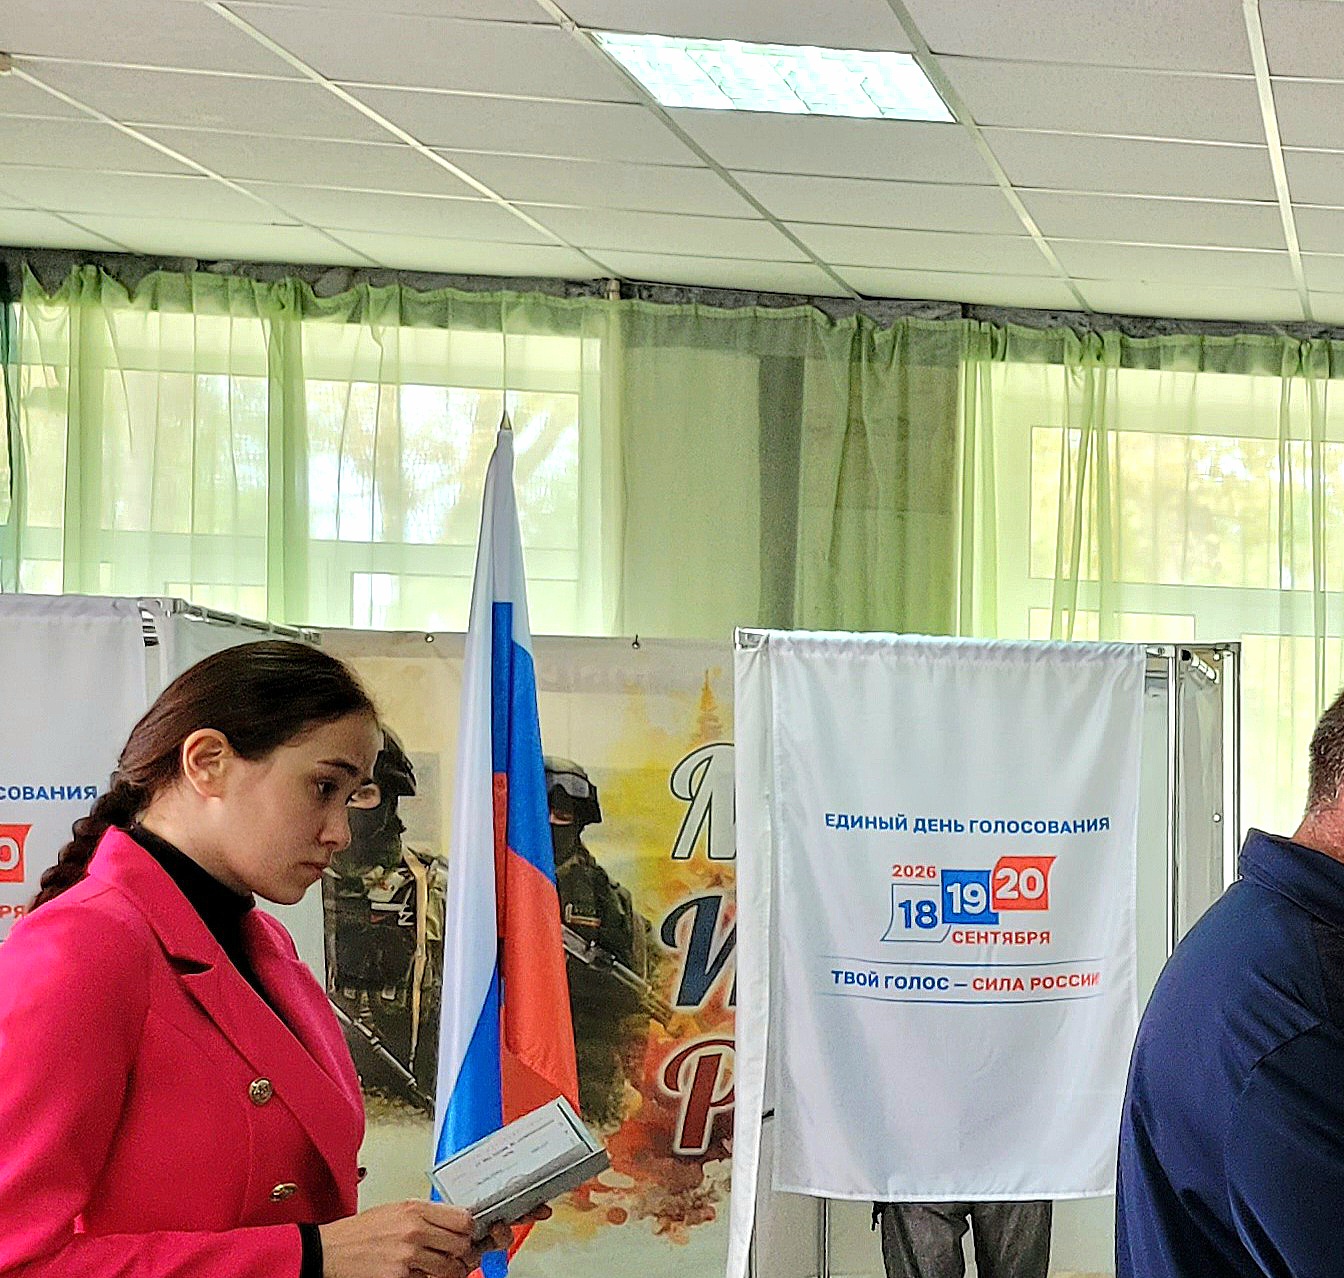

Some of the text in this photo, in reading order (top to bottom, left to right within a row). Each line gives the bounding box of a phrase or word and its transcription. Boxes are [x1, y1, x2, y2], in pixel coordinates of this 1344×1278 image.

[825, 812, 1110, 834] ЕДИНЫЙ ДЕНЬ ГОЛОСОВАНИЯ
[892, 864, 936, 879] 2026
[898, 867, 1046, 930] 18 19 20
[952, 929, 1051, 946] СЕНТЯБРЯ
[831, 969, 879, 989] ТВОЙ
[884, 970, 949, 990] ГОЛОС
[972, 976, 1024, 991] СИЛА
